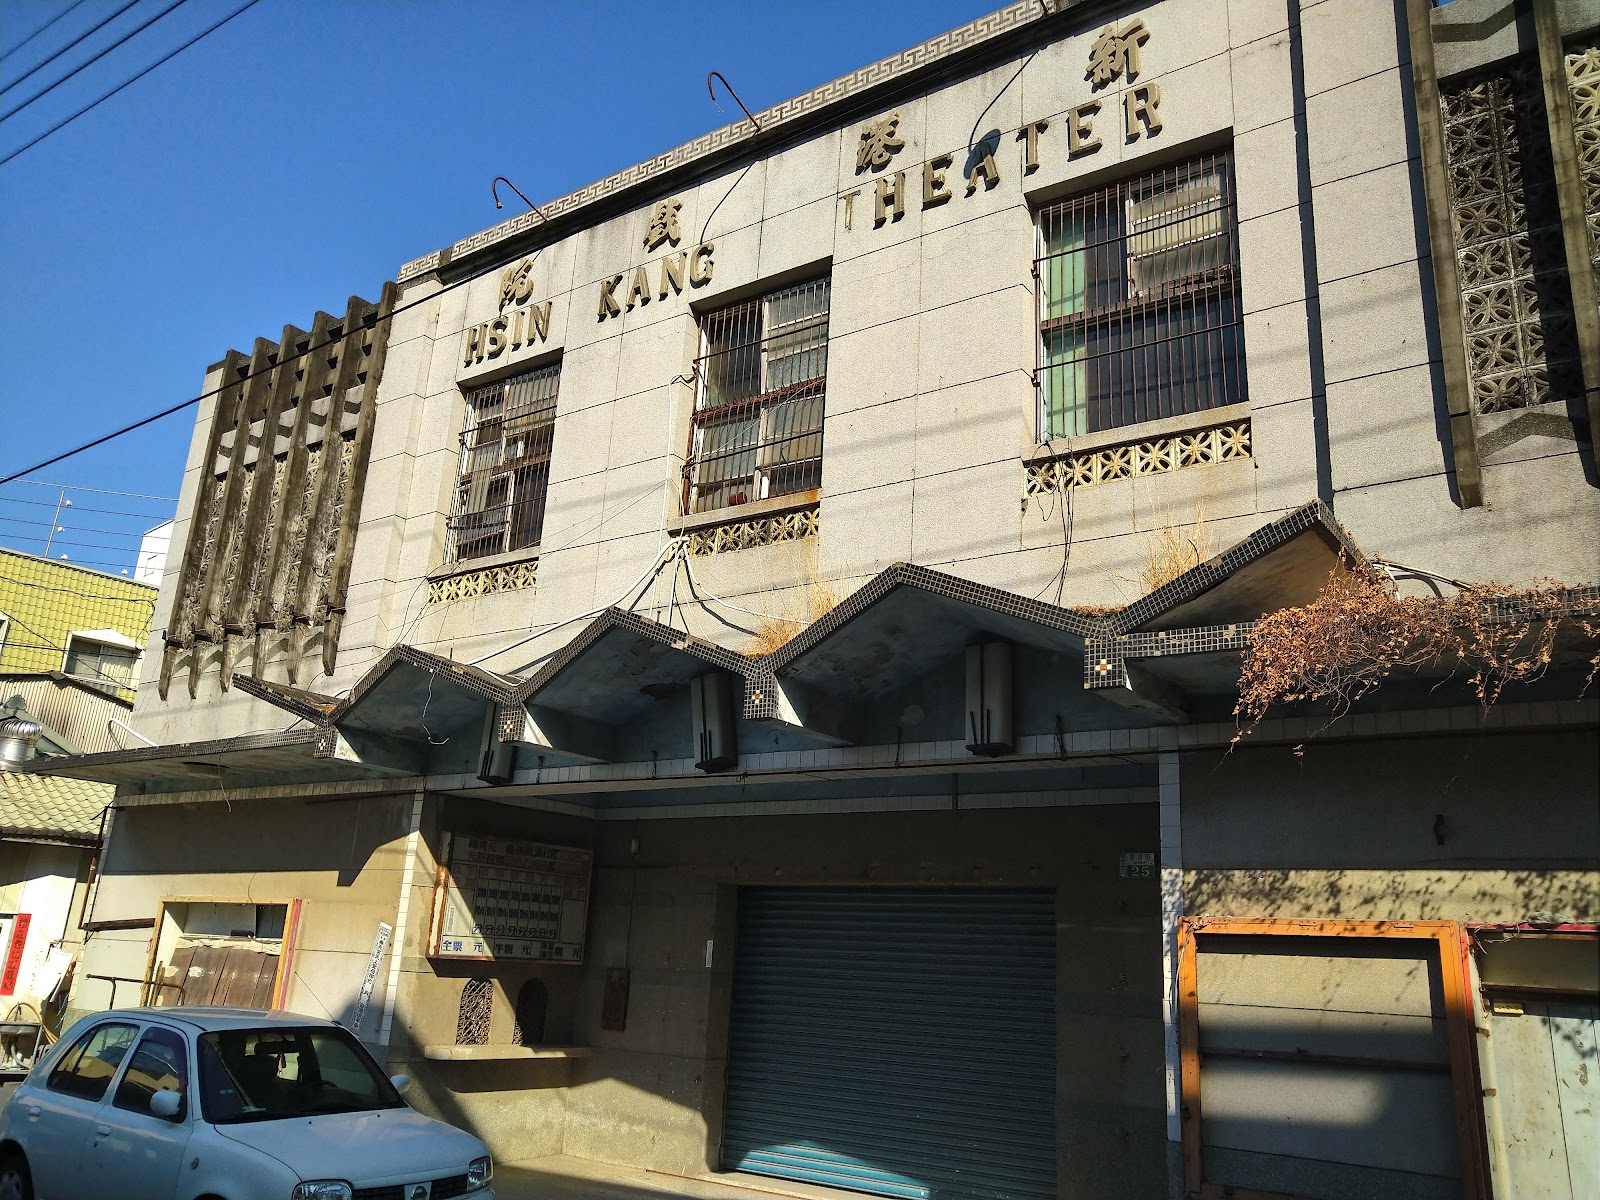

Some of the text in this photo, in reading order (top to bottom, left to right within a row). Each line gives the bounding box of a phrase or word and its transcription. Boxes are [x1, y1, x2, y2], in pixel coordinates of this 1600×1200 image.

[1084, 17, 1151, 91] 新
[855, 108, 905, 176] 港
[464, 83, 1164, 368] HSIN KANG THEATER
[499, 258, 535, 311] 院
[1131, 865, 1150, 877] 25
[443, 940, 463, 952] 全票
